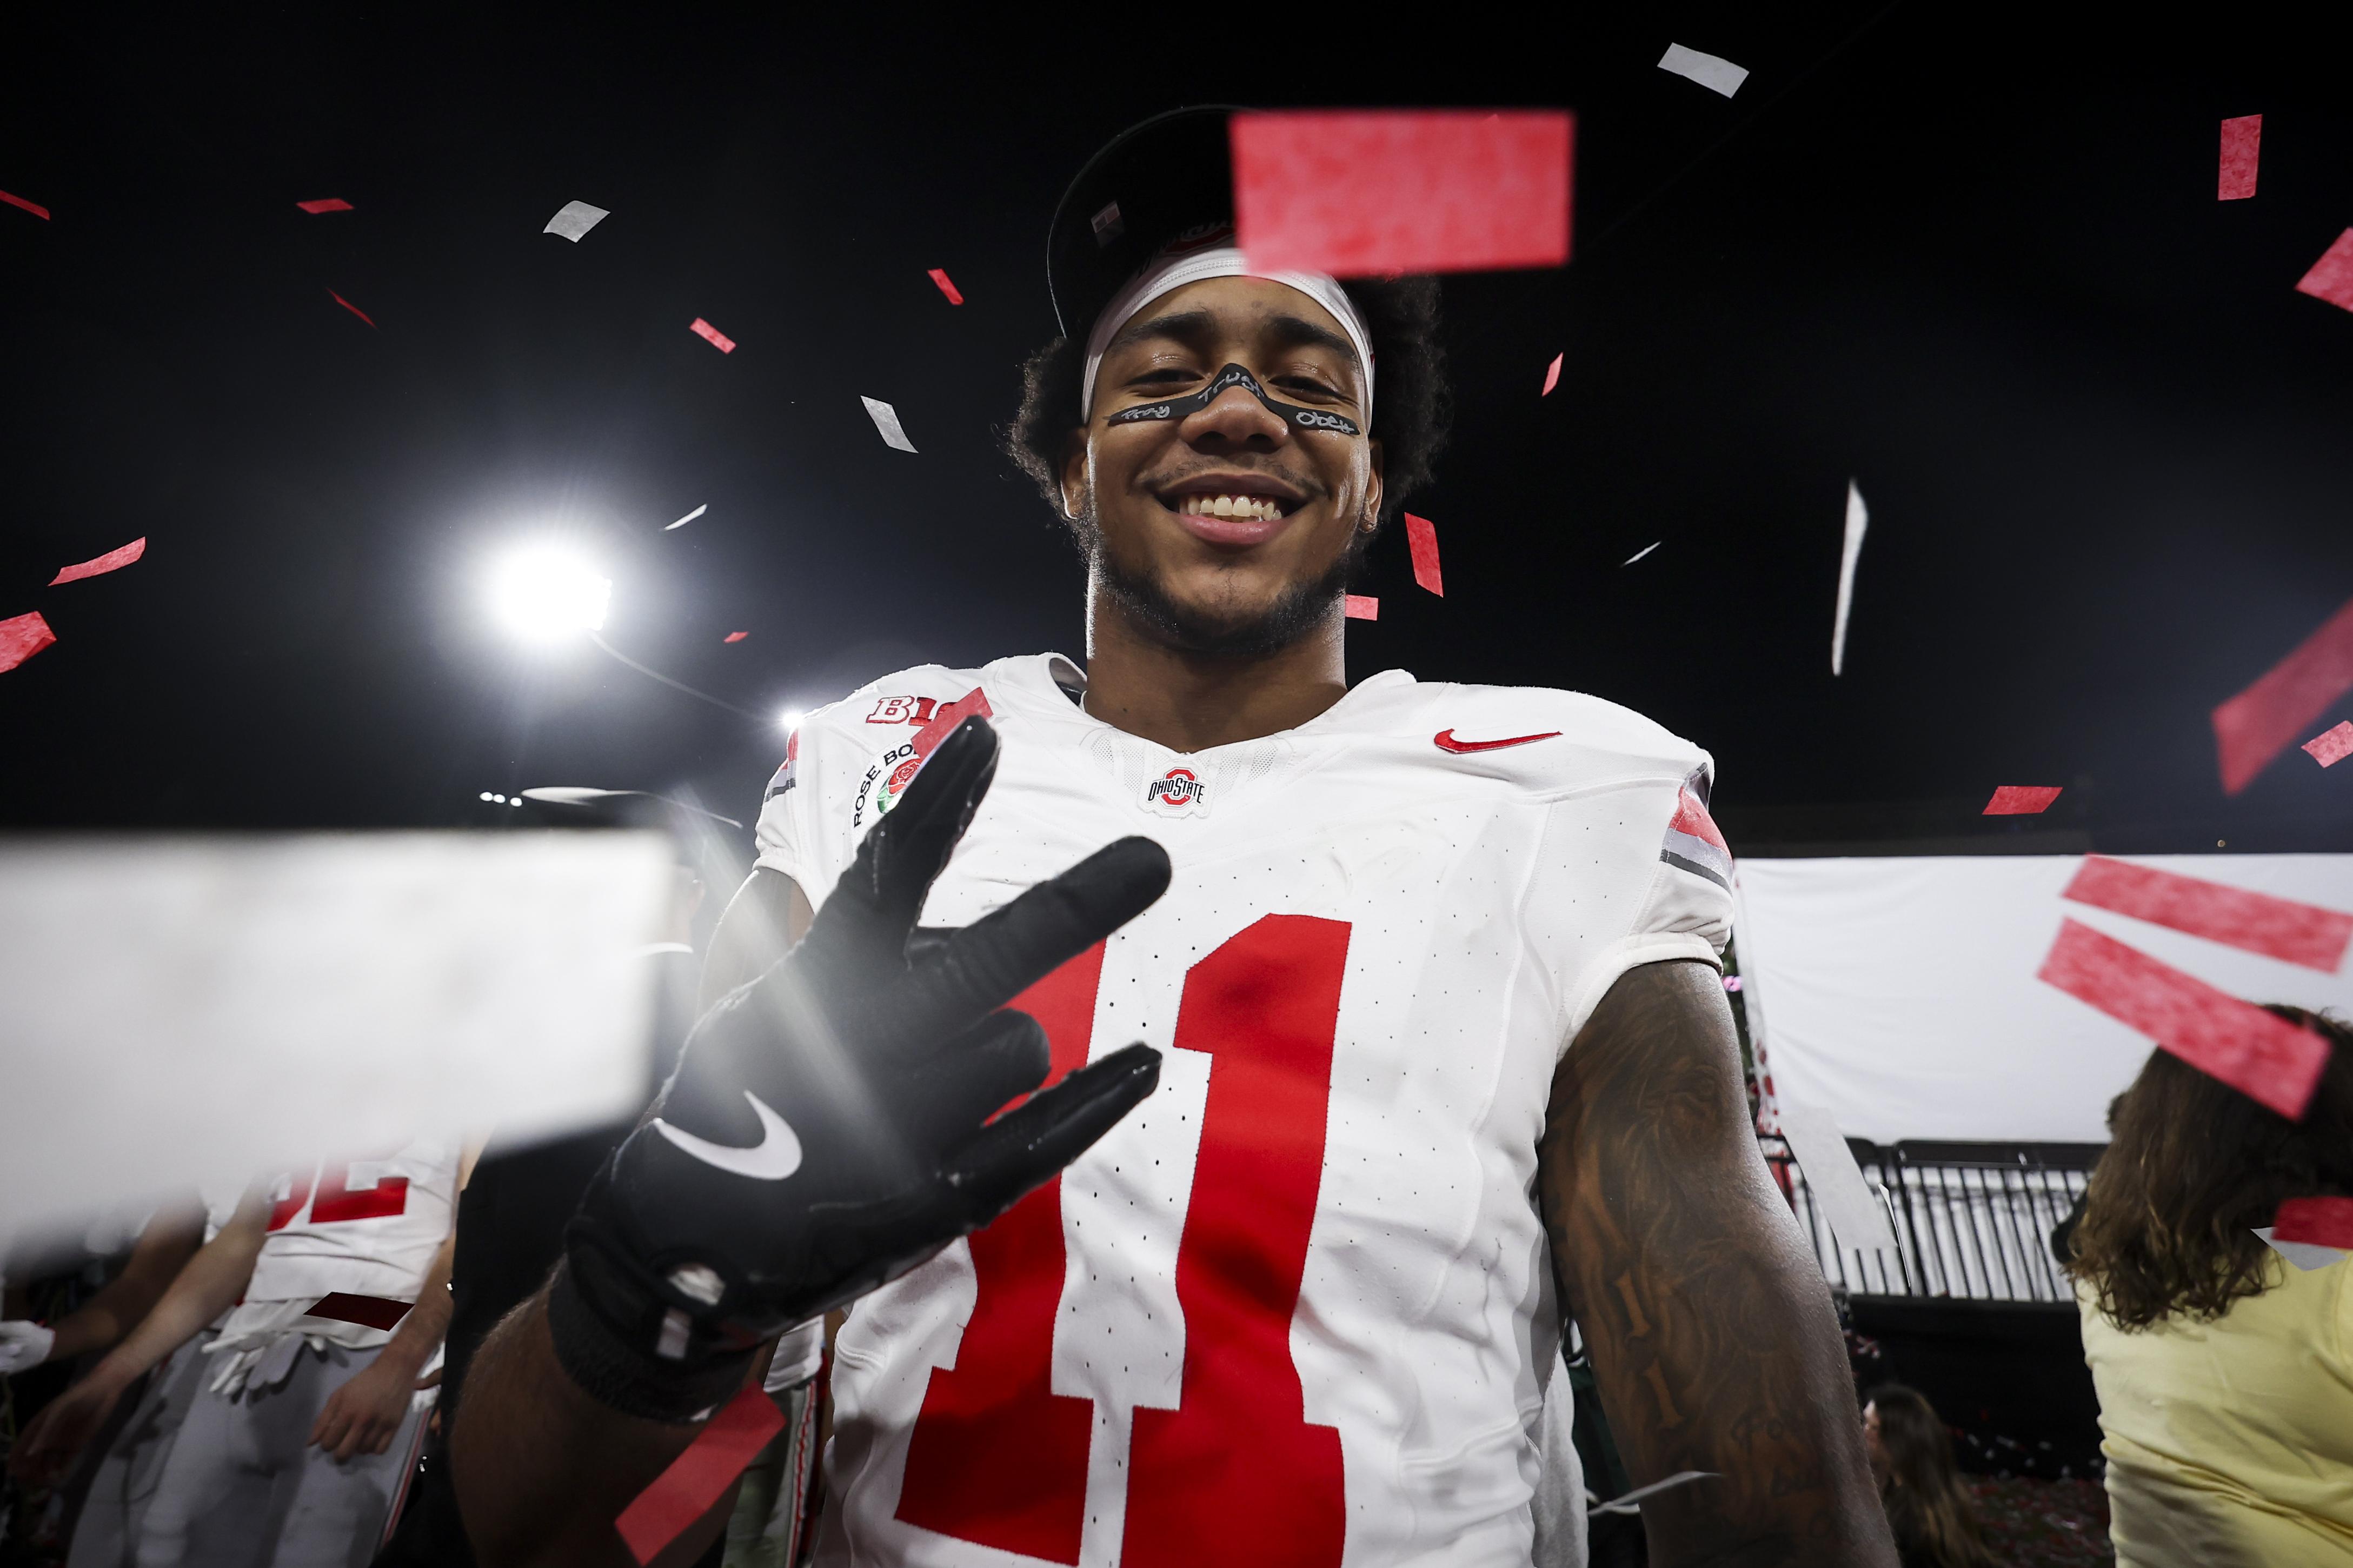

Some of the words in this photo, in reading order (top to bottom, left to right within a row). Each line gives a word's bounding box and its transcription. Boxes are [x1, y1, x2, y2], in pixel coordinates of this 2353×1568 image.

[1296, 411, 1354, 433] Obey
[854, 765, 881, 828] ROSE
[894, 913, 1352, 1568] 11
